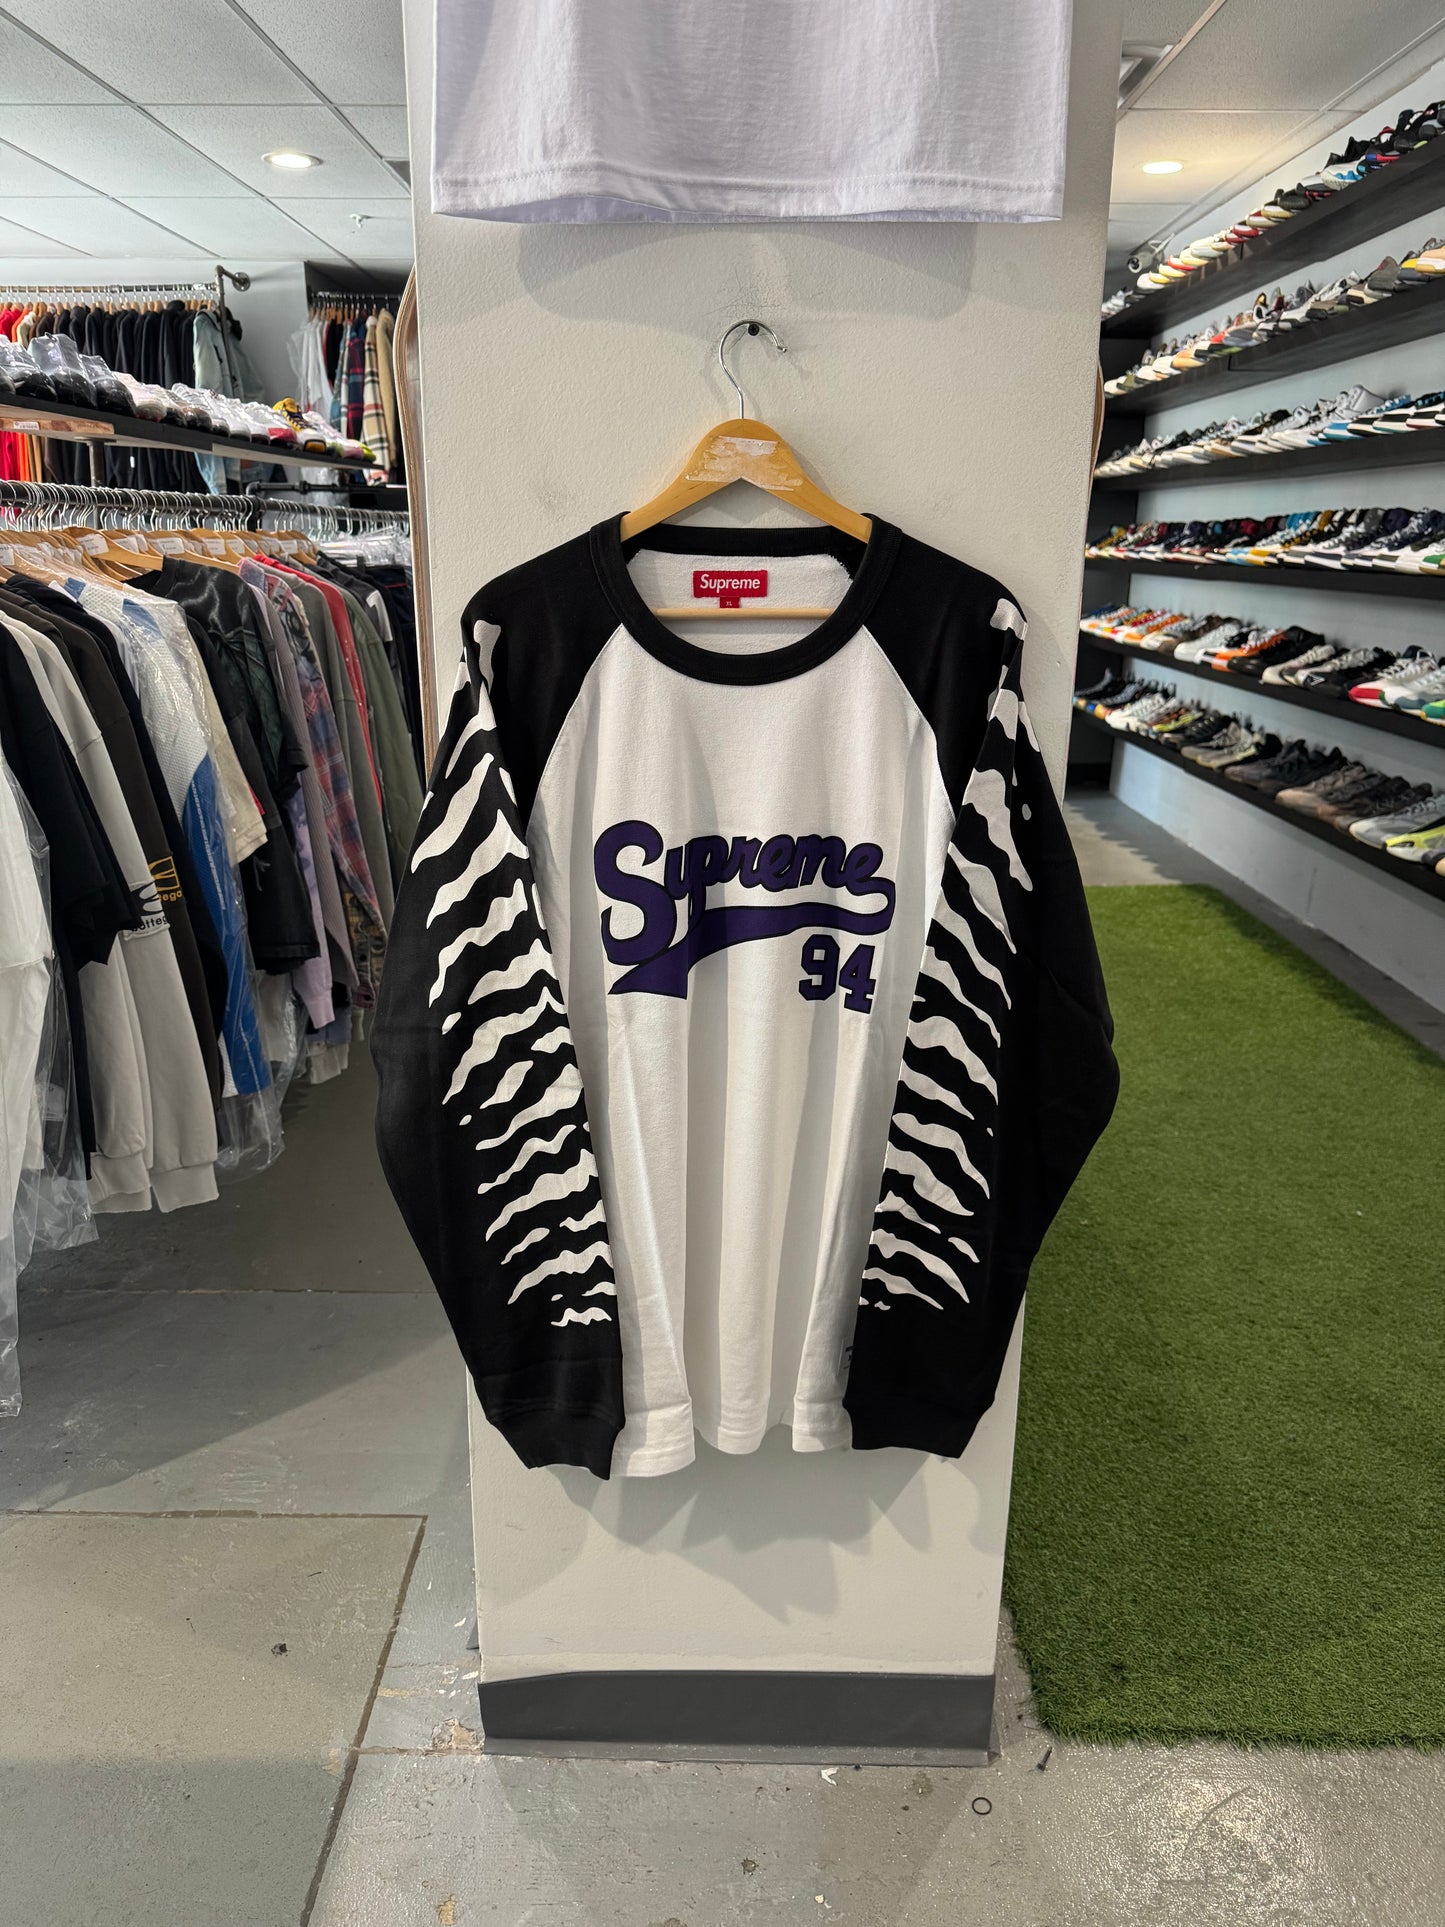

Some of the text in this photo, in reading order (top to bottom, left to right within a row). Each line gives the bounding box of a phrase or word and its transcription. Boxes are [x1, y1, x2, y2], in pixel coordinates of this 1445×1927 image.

[700, 573, 761, 594] Supreme
[593, 819, 897, 975] Supreme
[798, 933, 877, 1015] 94
